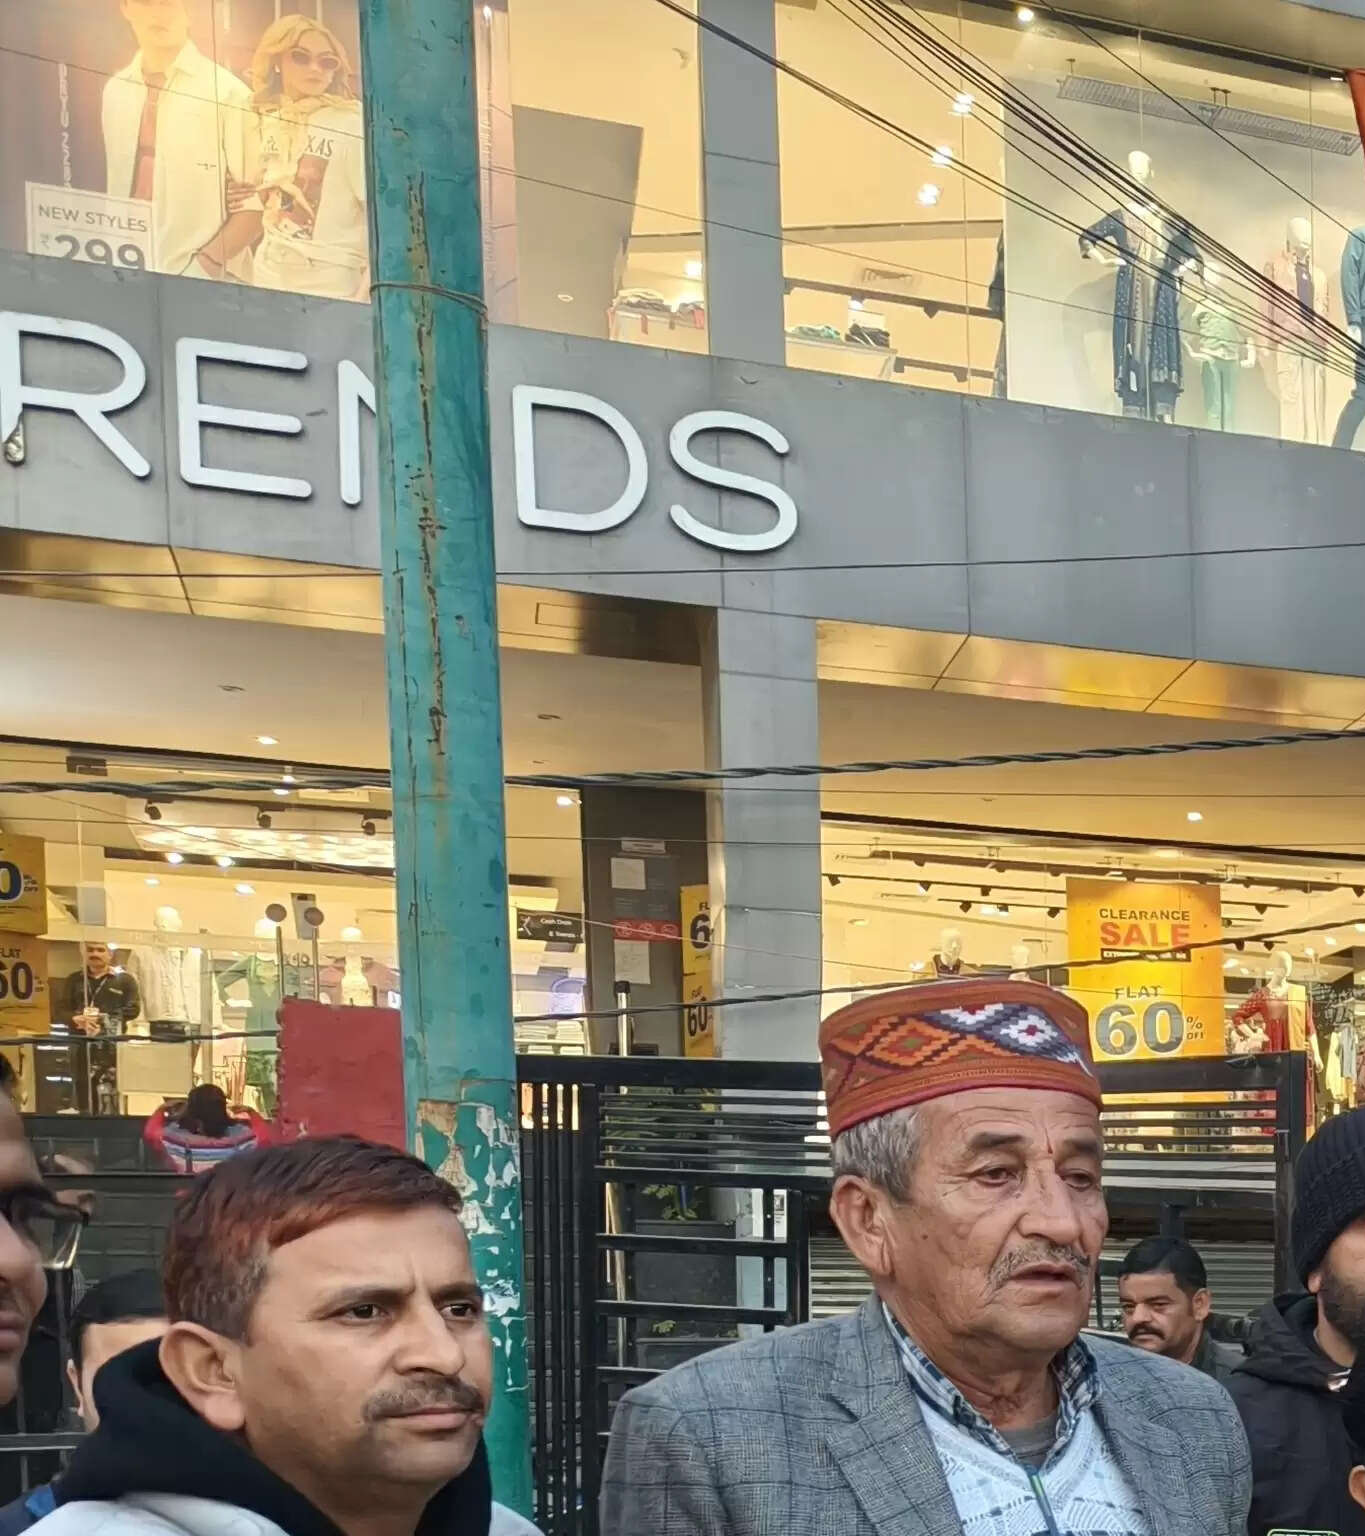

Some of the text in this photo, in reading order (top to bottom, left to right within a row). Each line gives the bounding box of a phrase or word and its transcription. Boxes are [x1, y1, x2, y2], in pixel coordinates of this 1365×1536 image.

[38, 205, 147, 232] NEW STYLES
[0, 311, 798, 552] REDS
[1100, 908, 1190, 922] CLEARANCE
[1100, 922, 1190, 948] SALE
[1115, 985, 1161, 1000] FLAT
[1096, 1001, 1184, 1056] 60
